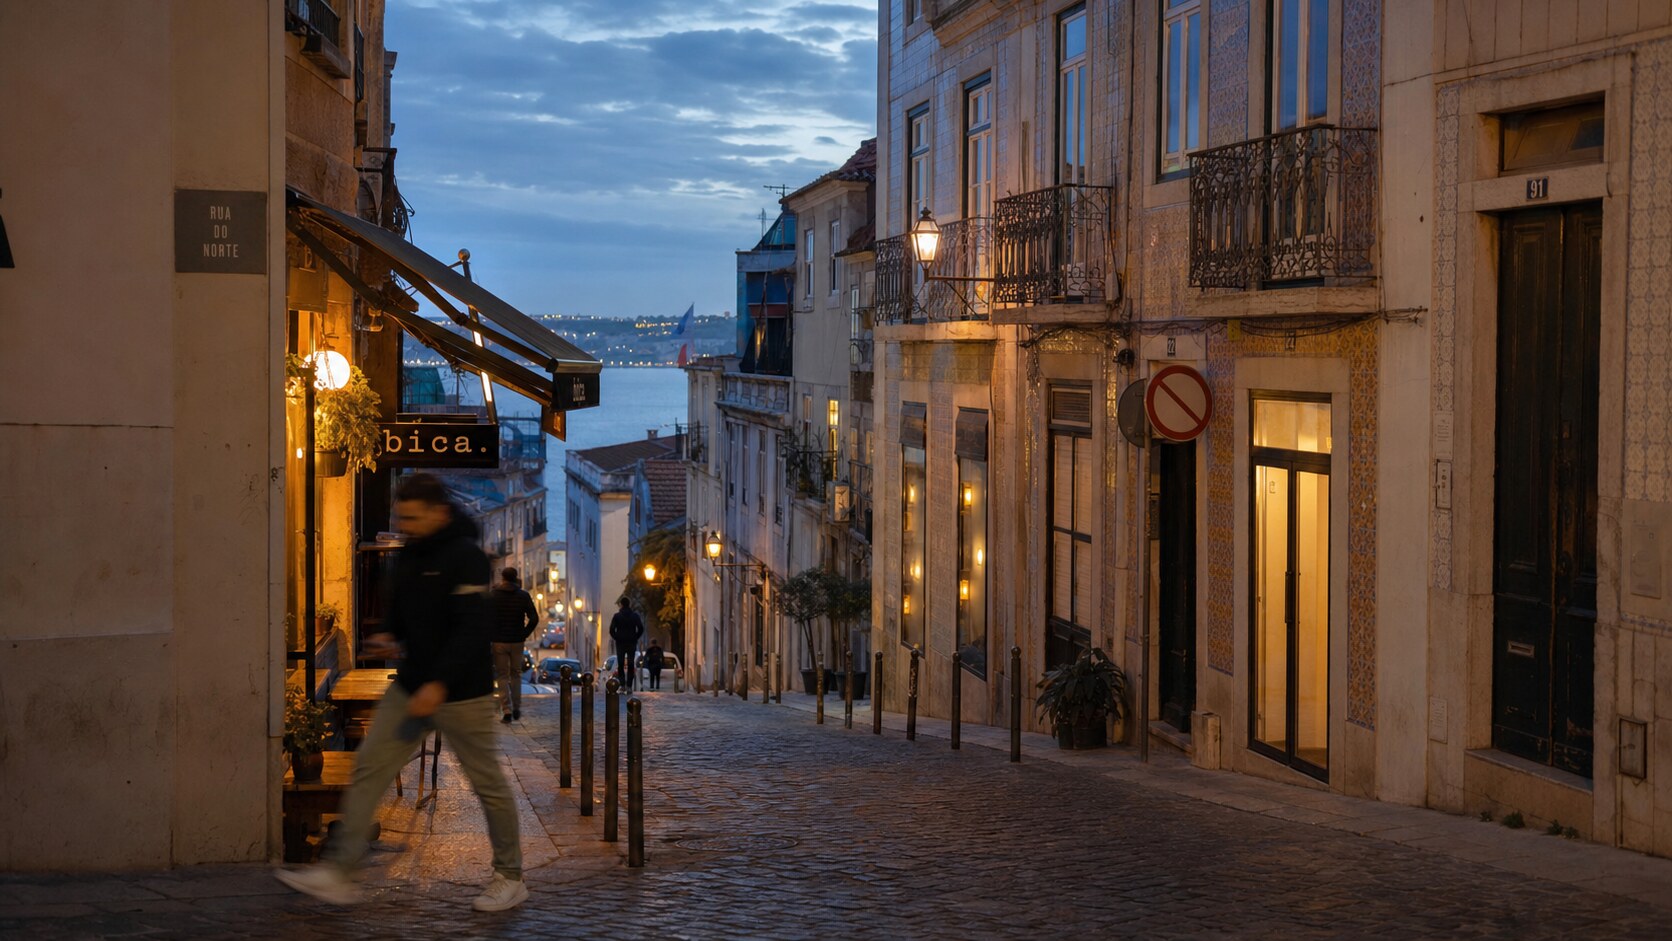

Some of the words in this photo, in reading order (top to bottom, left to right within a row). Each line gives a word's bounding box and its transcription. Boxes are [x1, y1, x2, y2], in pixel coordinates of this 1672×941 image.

[1530, 180, 1543, 199] 91
[210, 206, 231, 220] RUA
[214, 225, 228, 239] DO
[203, 243, 239, 258] NORTE
[382, 429, 487, 453] bica.
